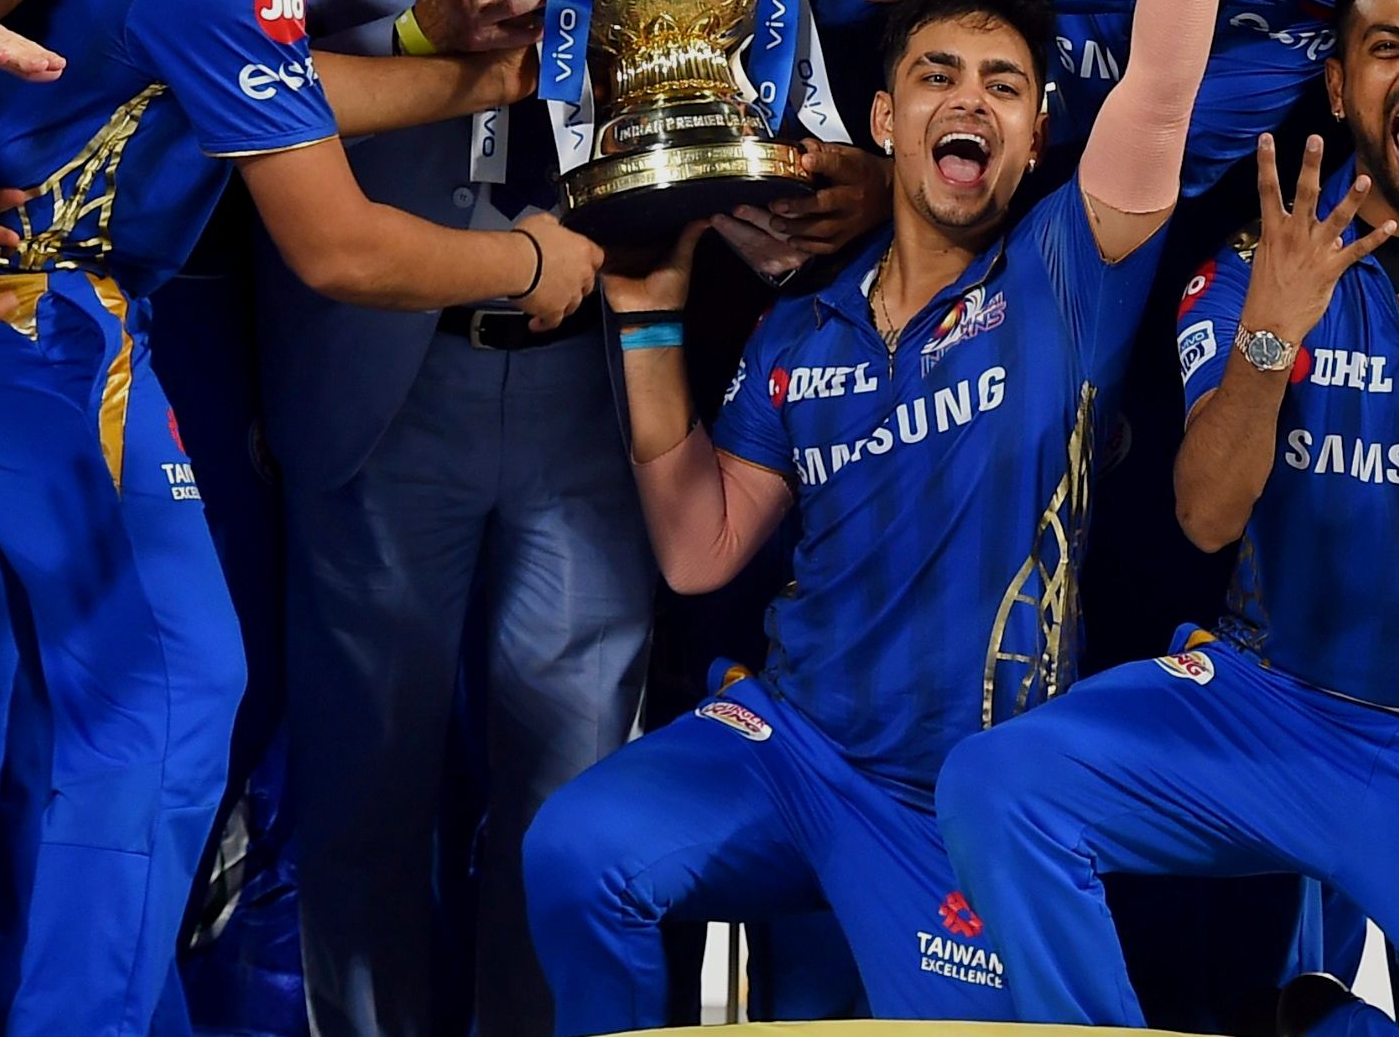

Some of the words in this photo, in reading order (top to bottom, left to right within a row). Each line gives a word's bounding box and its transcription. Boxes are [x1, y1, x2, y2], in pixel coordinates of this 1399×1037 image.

[552, 8, 578, 83] vivo
[798, 59, 828, 125] vivo
[564, 102, 585, 151] viv
[665, 114, 726, 131] PREMIER
[787, 362, 878, 402] DHFL
[1310, 348, 1393, 393] DHFL
[917, 931, 1004, 976] TAIWAN
